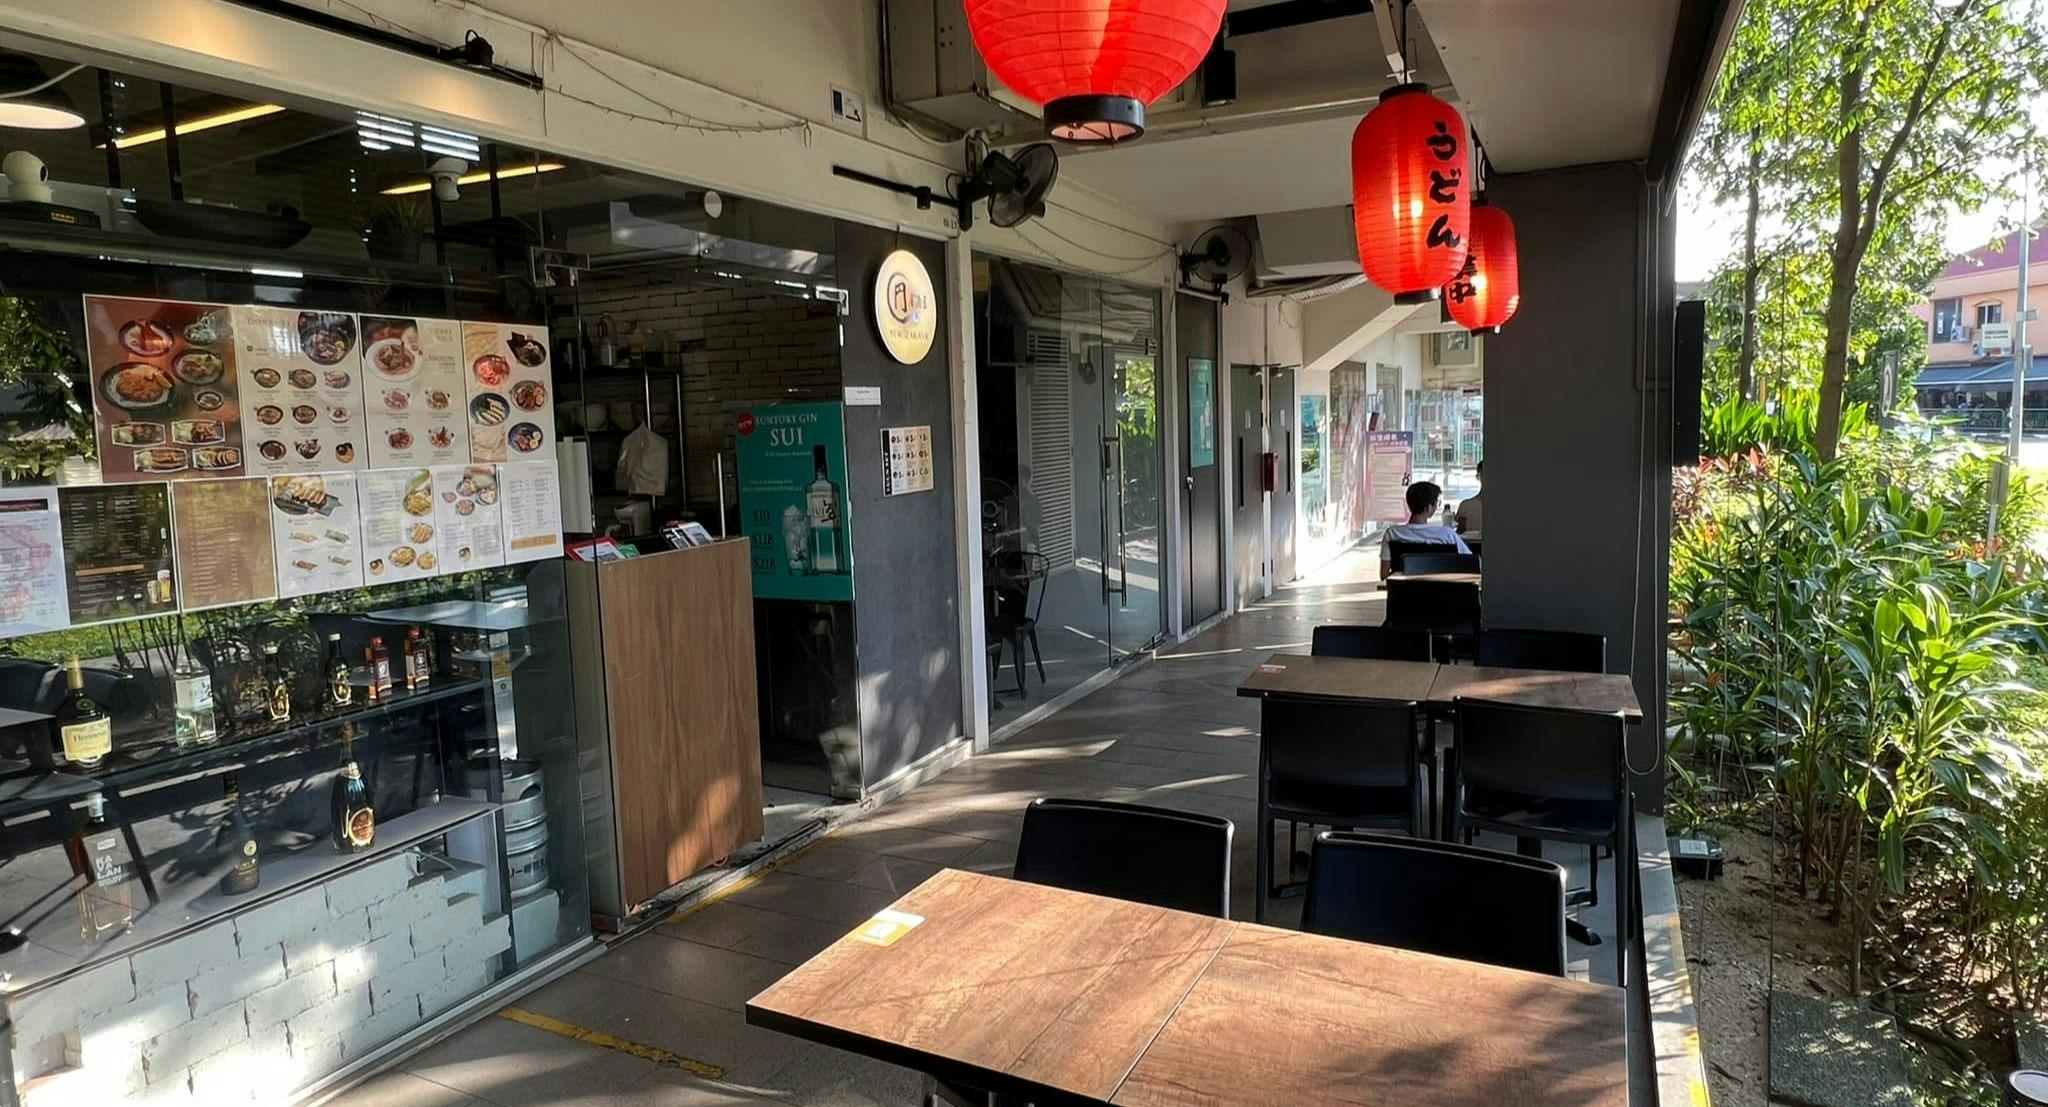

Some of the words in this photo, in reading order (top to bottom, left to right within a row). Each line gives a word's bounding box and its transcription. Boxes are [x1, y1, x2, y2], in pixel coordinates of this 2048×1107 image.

[1425, 121, 1462, 250] うどん
[755, 414, 797, 426] SUNTORY
[799, 412, 818, 424] GIN
[770, 427, 804, 447] SUI
